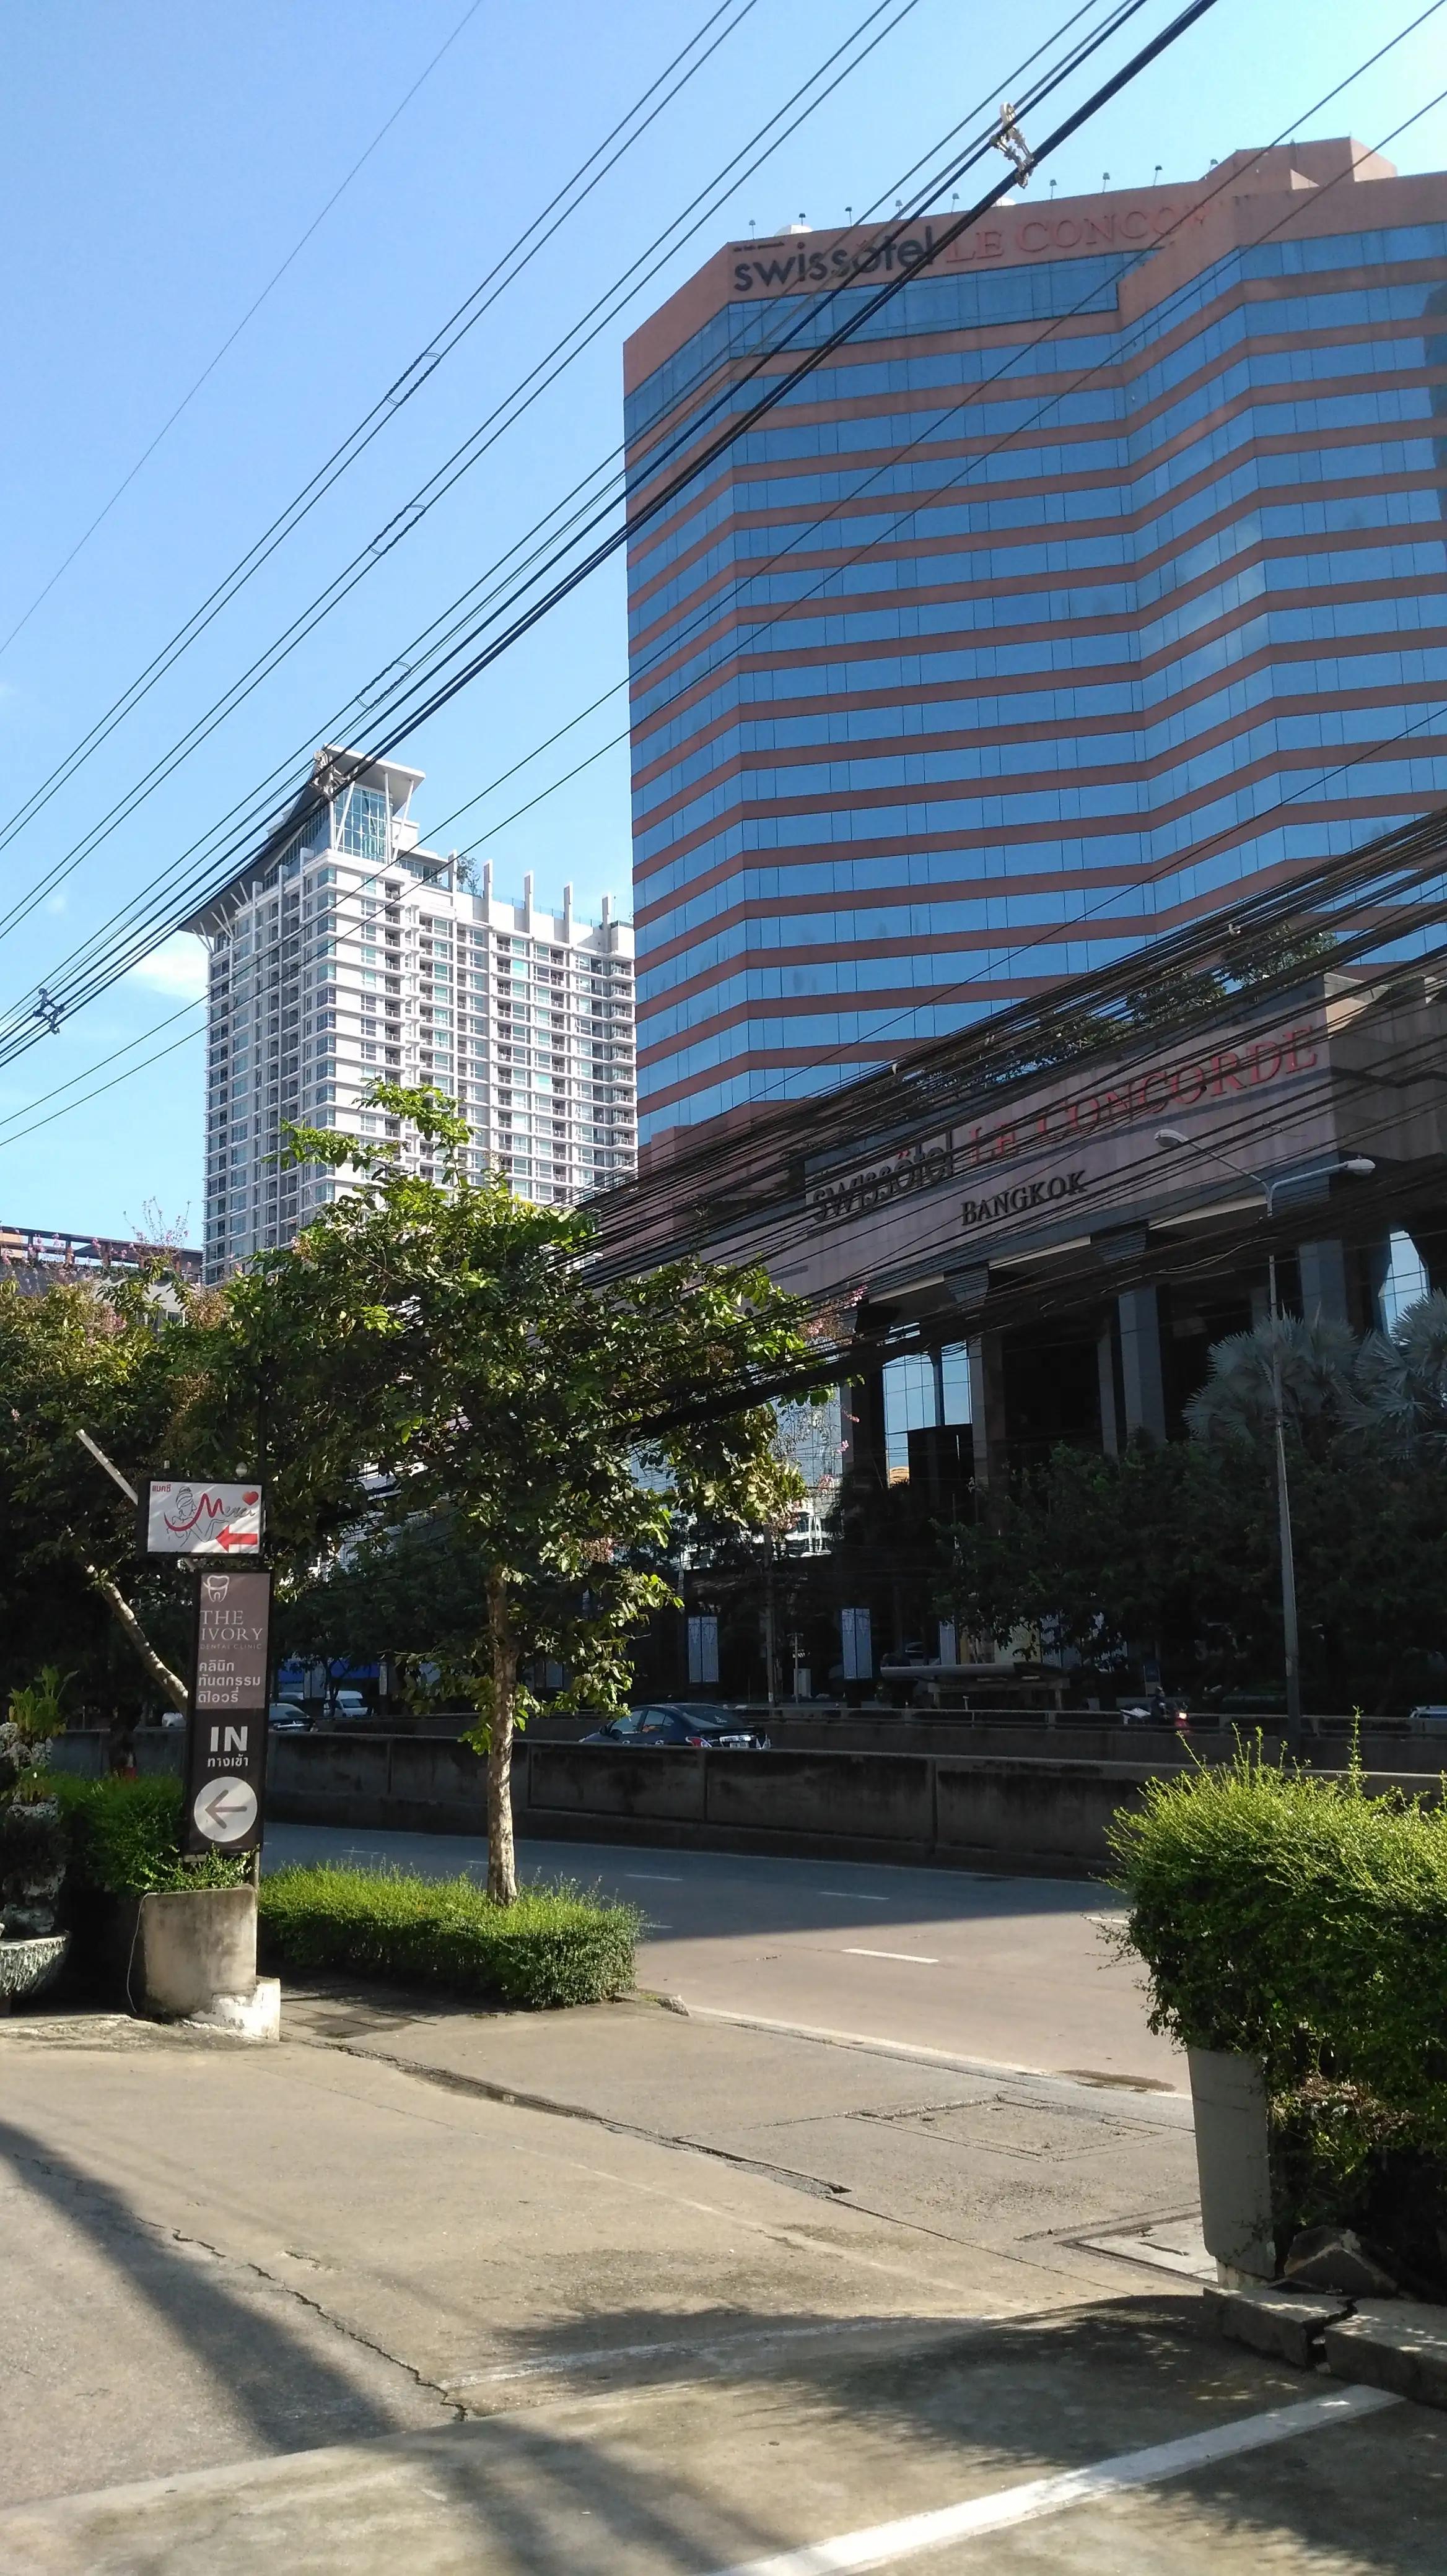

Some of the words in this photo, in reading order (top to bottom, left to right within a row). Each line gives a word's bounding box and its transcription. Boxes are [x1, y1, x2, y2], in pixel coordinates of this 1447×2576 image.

[946, 230, 1003, 263] LE
[961, 1170, 1088, 1226] BANGKOK
[199, 1610, 243, 1625] THE
[201, 1627, 263, 1641] IVORY
[199, 1660, 234, 1671] คลินิก
[198, 1674, 261, 1686] ทันตกรรม
[210, 1726, 248, 1752] IN
[207, 1754, 248, 1767] ทางเข้า
